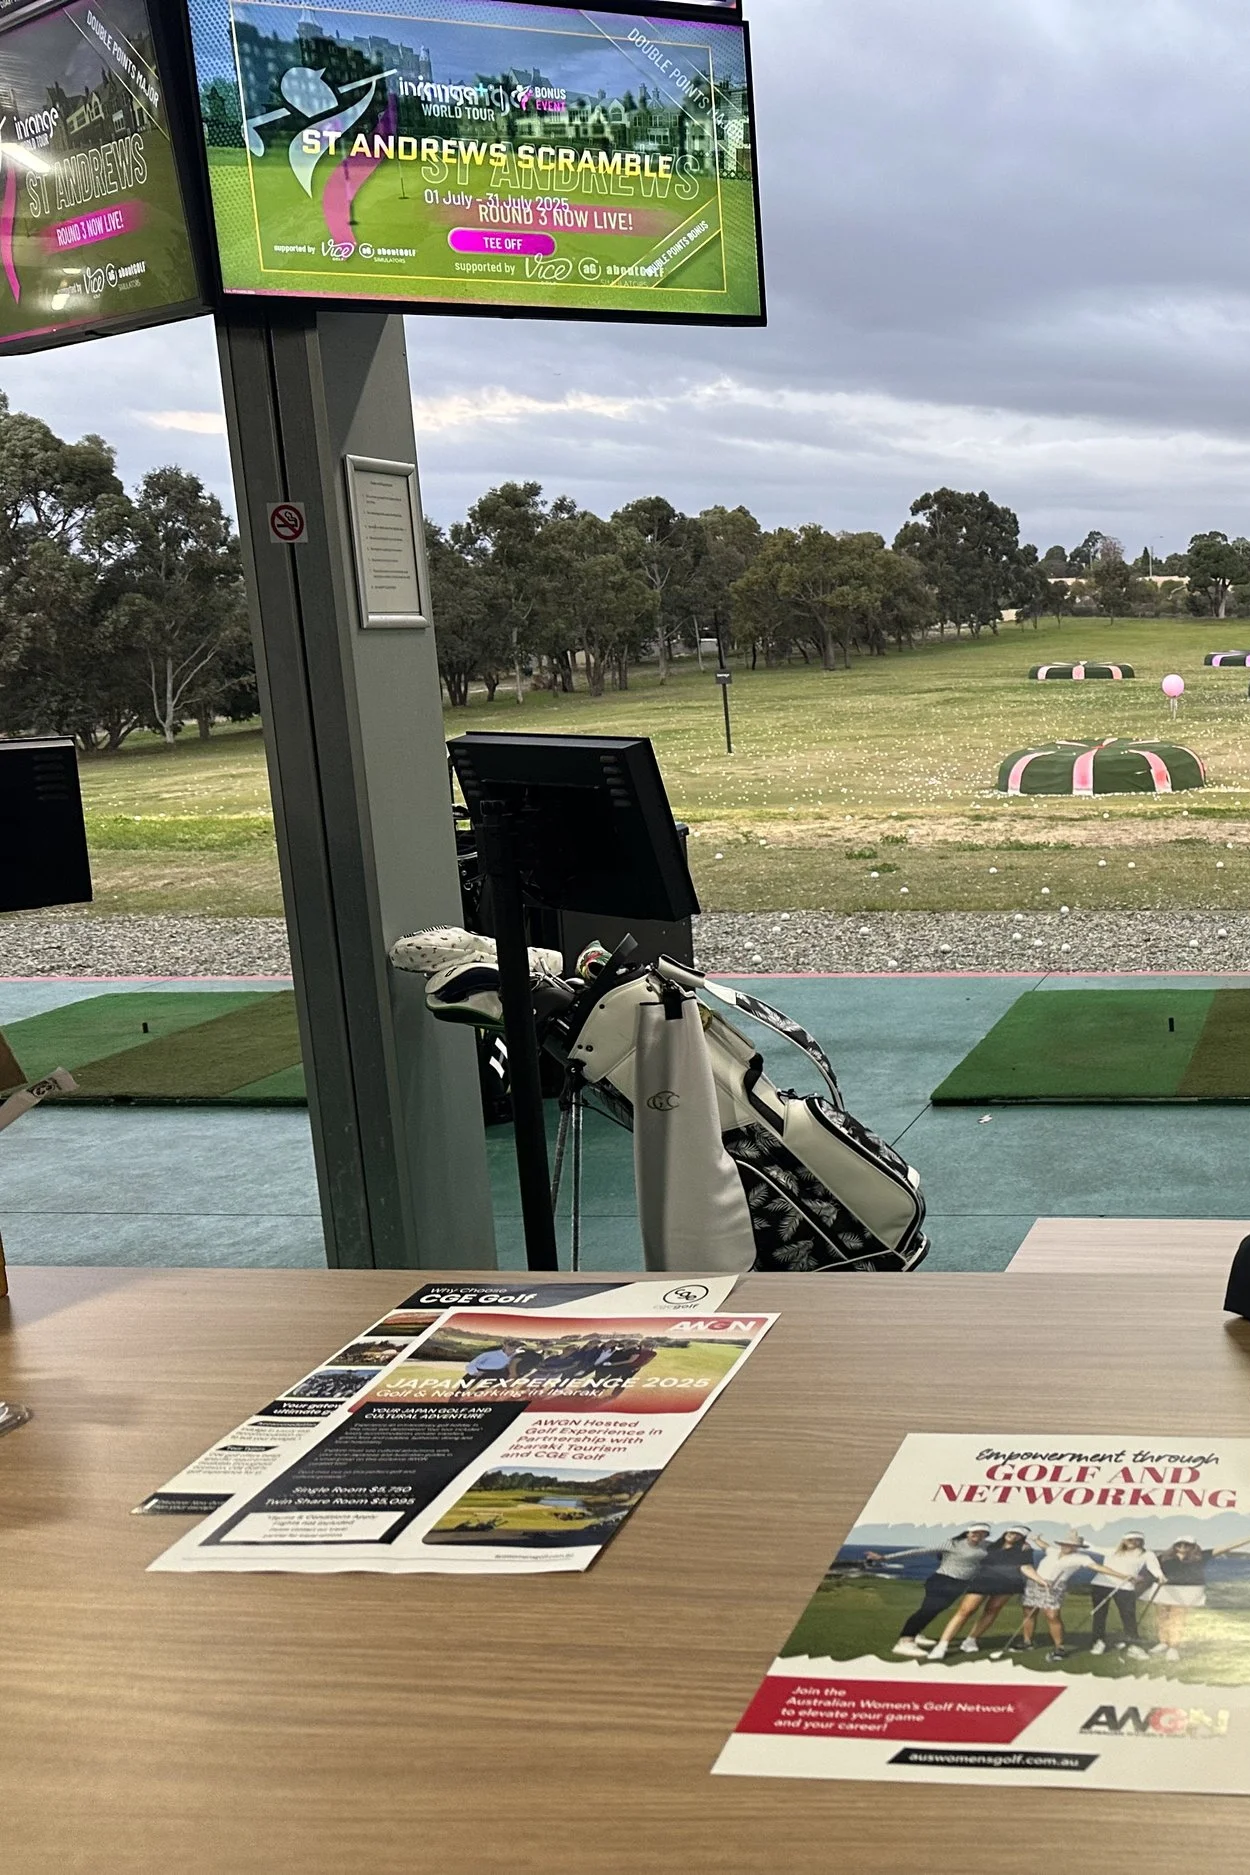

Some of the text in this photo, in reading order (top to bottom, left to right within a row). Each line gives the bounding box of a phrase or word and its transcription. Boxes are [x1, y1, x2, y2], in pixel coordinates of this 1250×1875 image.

[87, 10, 160, 108] DOUBLE POINTS MAJOR
[627, 27, 710, 109] DOUBLE POINTS
[535, 87, 566, 99] BONUS
[422, 103, 495, 122] WORLD TOUR
[536, 100, 566, 112] EVENT
[14, 106, 59, 140] inrange
[303, 128, 674, 179] ST ANDREWS SCRAMBLE
[26, 133, 148, 218] ST ANDREWS
[490, 142, 700, 200] ANDREWS
[424, 189, 570, 212] 01 July 31 July 2025
[479, 205, 633, 231] ROUND 3 NOW LIVE!
[56, 210, 124, 246] ROUND 3 NOW LIVE!
[483, 236, 523, 250] TEE OFF
[667, 220, 709, 259] POINTS BONUS
[274, 244, 315, 255] supported by
[321, 239, 355, 258] Vice
[455, 260, 515, 276] supported by
[525, 252, 573, 281] Vice
[83, 266, 105, 294] Vice
[419, 1293, 537, 1304] CGE Golf
[430, 1287, 455, 1295] Why
[666, 1320, 757, 1332] AWGN
[385, 1377, 711, 1389] JAPAN EXPERIENCE 2025
[377, 1389, 604, 1399] Golf & Networking in Ibaraki
[534, 1419, 639, 1428] AWGN Hosted
[525, 1427, 663, 1438] Golf Experience in
[508, 1443, 627, 1453] Ibaraki Tourism
[516, 1436, 643, 1446] Partnership with
[500, 1451, 606, 1462] and CGE Golf
[976, 1448, 1220, 1468] Empowerment through
[986, 1463, 1201, 1485] GOLF AND
[292, 1486, 412, 1495] Single Room $5,750
[931, 1484, 1238, 1508] NETWORKING
[792, 1686, 847, 1696] Join the
[786, 1696, 1015, 1714] Australian Women's Golf Network
[781, 1708, 924, 1723] to elevate your game
[774, 1719, 888, 1732] and your career!
[908, 1753, 1079, 1767] auswomensgolf.com.au
